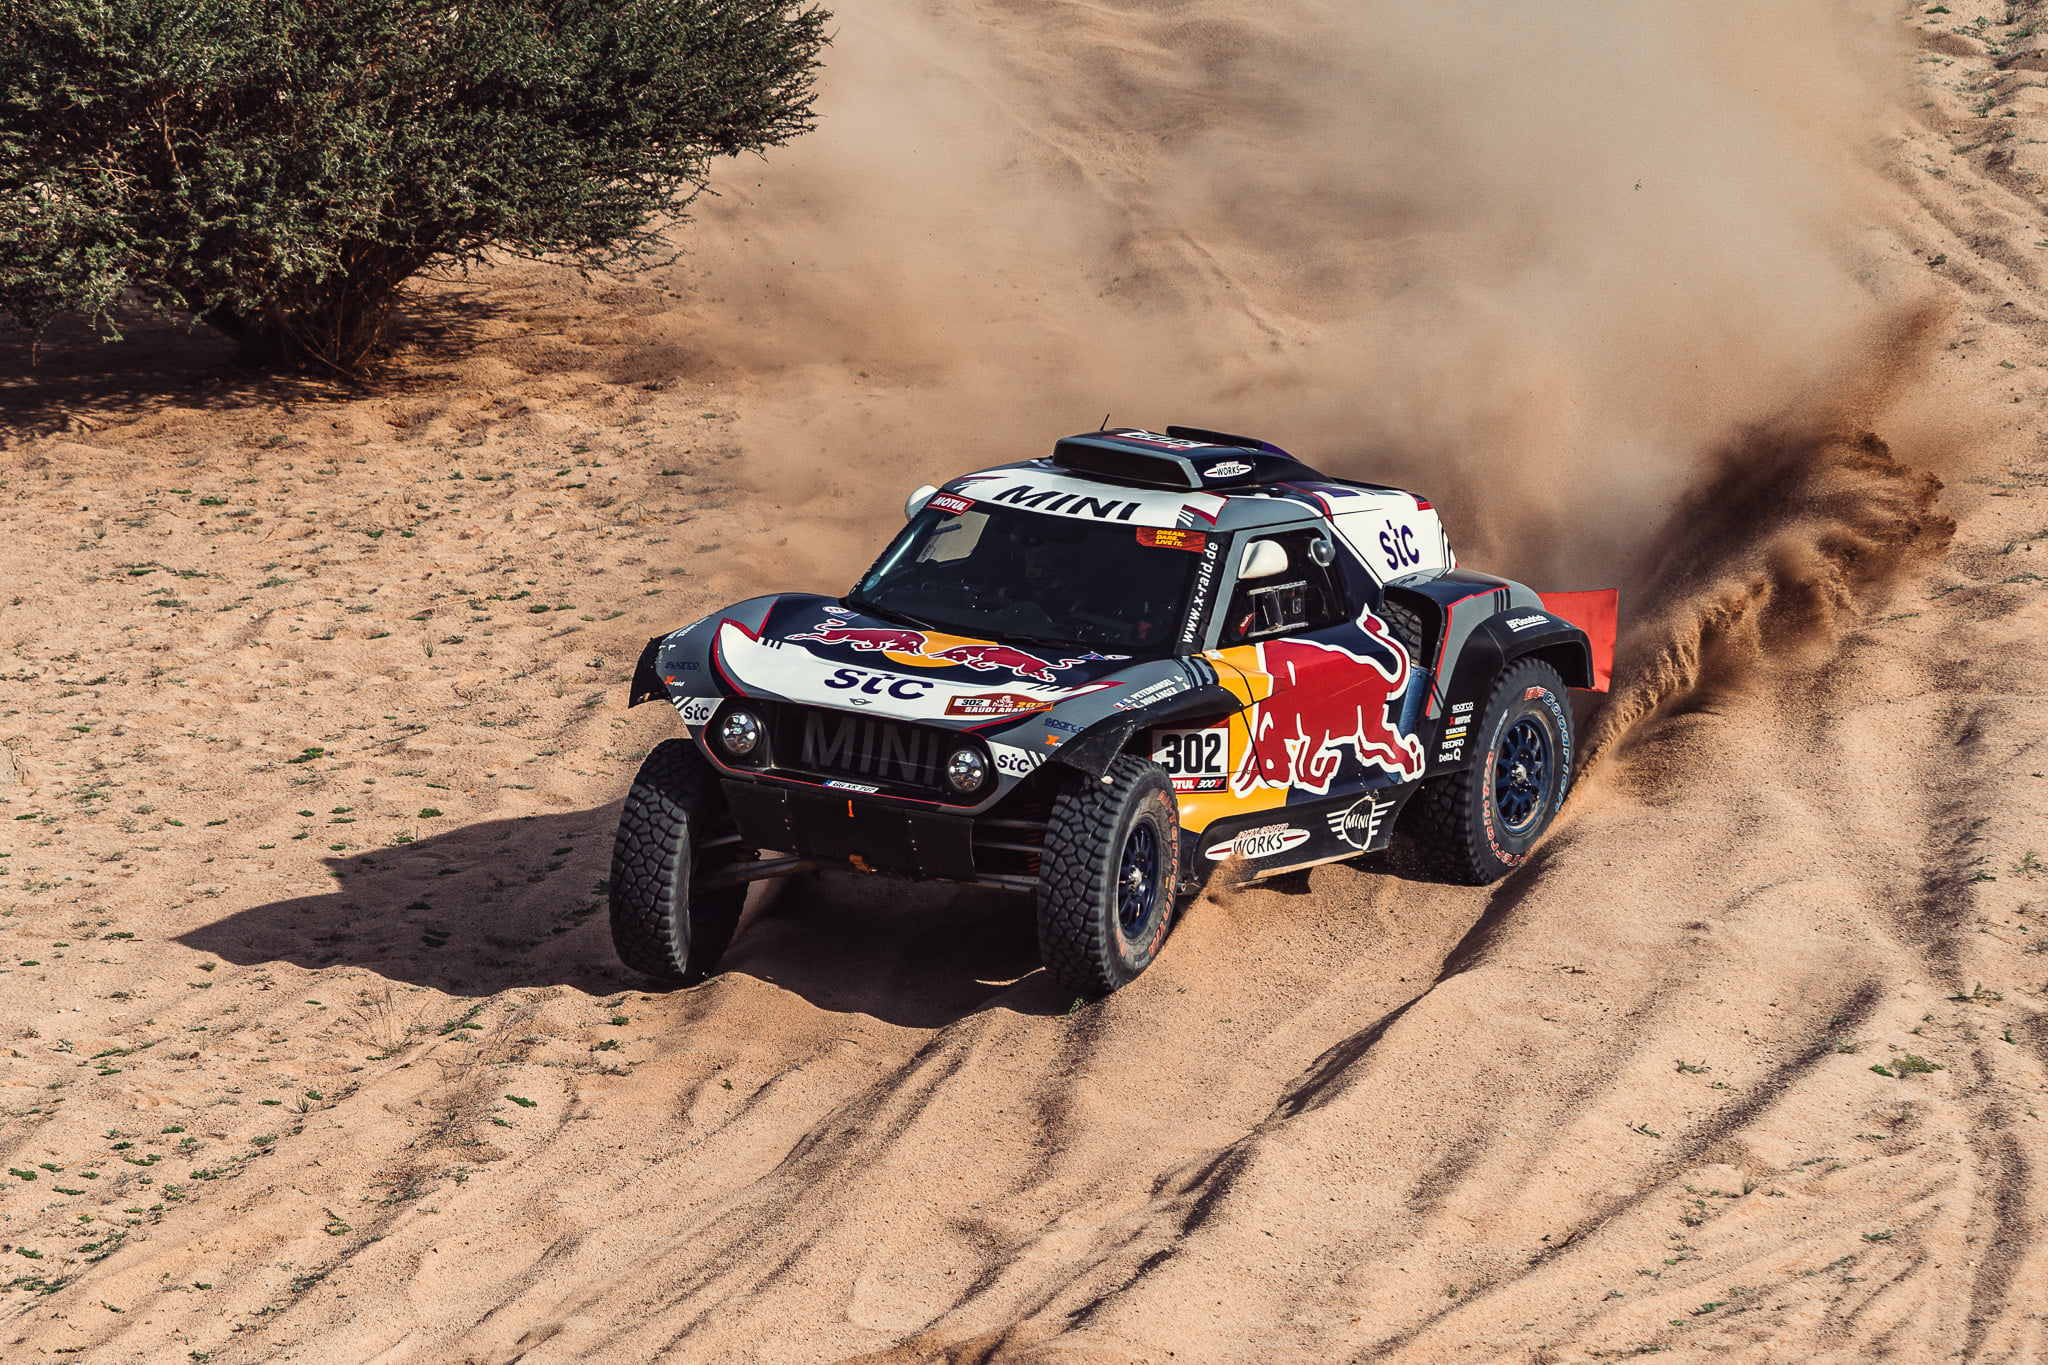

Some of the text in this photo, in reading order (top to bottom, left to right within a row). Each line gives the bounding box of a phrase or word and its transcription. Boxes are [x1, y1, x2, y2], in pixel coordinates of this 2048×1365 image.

[1216, 466, 1240, 476] WORKS
[932, 496, 968, 512] MOTUL
[992, 485, 1142, 521] MINI
[1182, 542, 1218, 643] www.x-raid.de
[801, 710, 939, 785] MINI
[1161, 733, 1222, 774] 302
[1235, 822, 1289, 839] JOHN COOPER
[1345, 813, 1371, 830] MINI
[1234, 832, 1284, 856] WORKS
